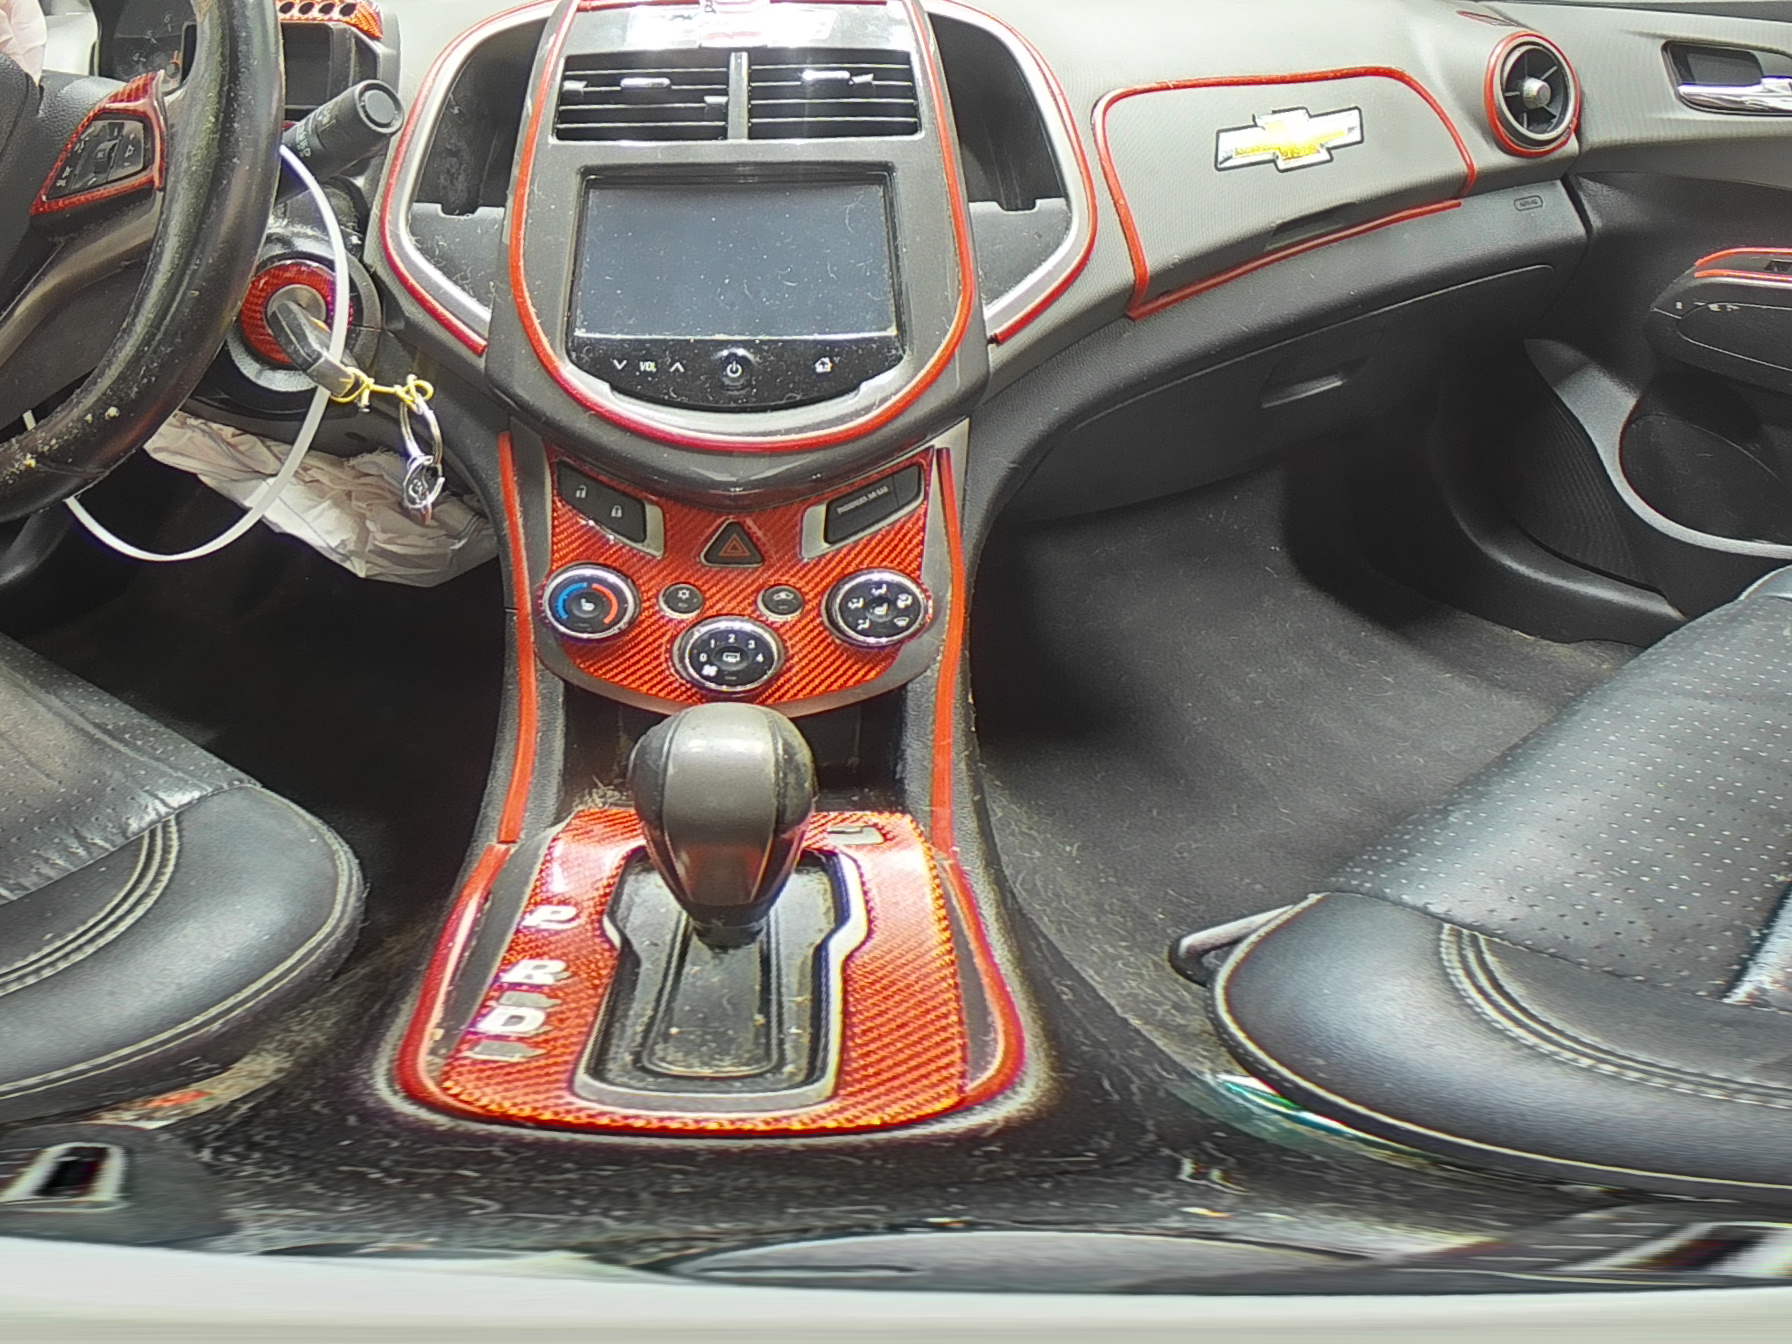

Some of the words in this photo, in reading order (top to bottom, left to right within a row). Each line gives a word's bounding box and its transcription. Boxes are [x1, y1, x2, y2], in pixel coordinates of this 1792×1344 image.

[639, 360, 657, 373] VOL
[728, 633, 735, 643] 2
[748, 639, 755, 649] 3
[756, 653, 764, 663] 4
[521, 905, 579, 930] P
[499, 959, 570, 986] R
[476, 1006, 552, 1035] D
